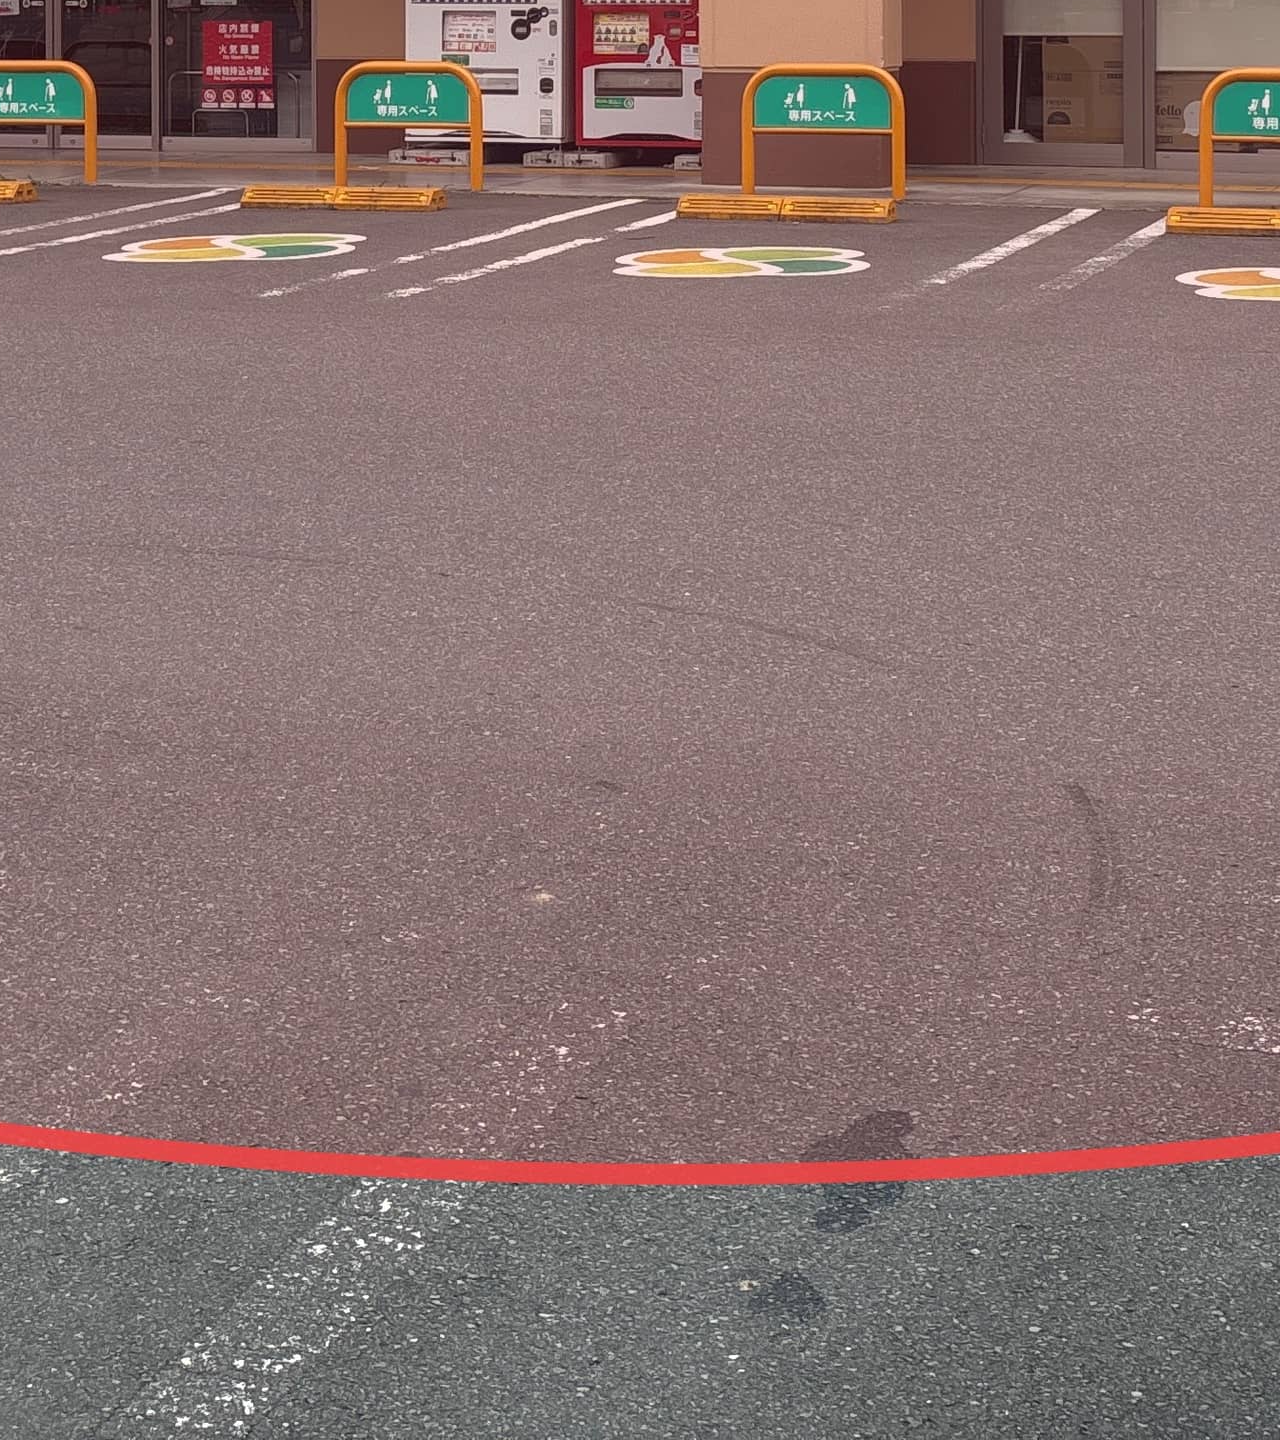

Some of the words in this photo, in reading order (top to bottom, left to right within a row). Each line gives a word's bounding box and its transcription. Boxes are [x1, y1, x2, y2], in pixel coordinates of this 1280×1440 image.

[0, 102, 56, 114] 専用スペース
[376, 105, 438, 117] 専用スペース
[788, 110, 856, 122] 専用スペース
